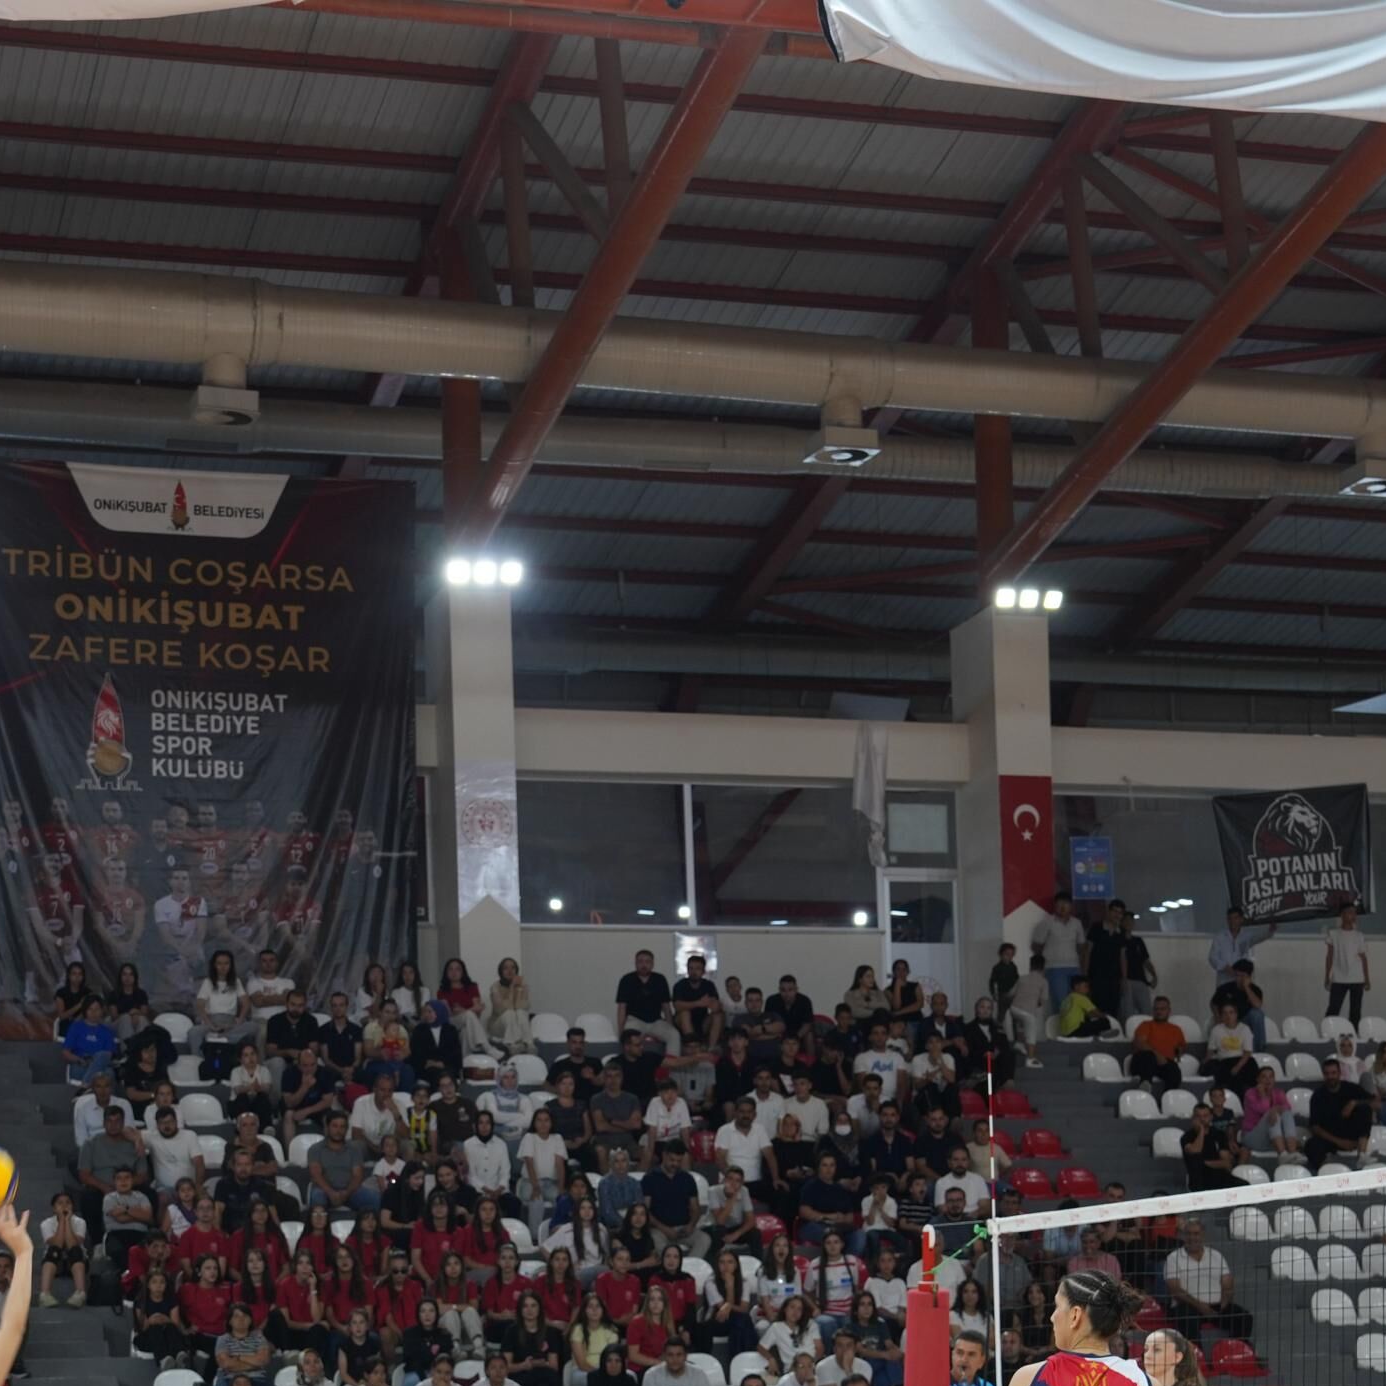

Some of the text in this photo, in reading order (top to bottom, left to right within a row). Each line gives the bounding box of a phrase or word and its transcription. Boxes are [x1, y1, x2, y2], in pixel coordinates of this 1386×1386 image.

[1, 545, 355, 594] TRİBÜN COŞARSA
[54, 589, 305, 633] ONİKİŞUBAT
[29, 633, 331, 678] ZAFERE KOŞAR
[152, 736, 213, 755] SPOR
[151, 757, 245, 779] KULÜBÜ
[1256, 852, 1337, 878] POTANIN
[1248, 872, 1351, 902] ASLANLARI
